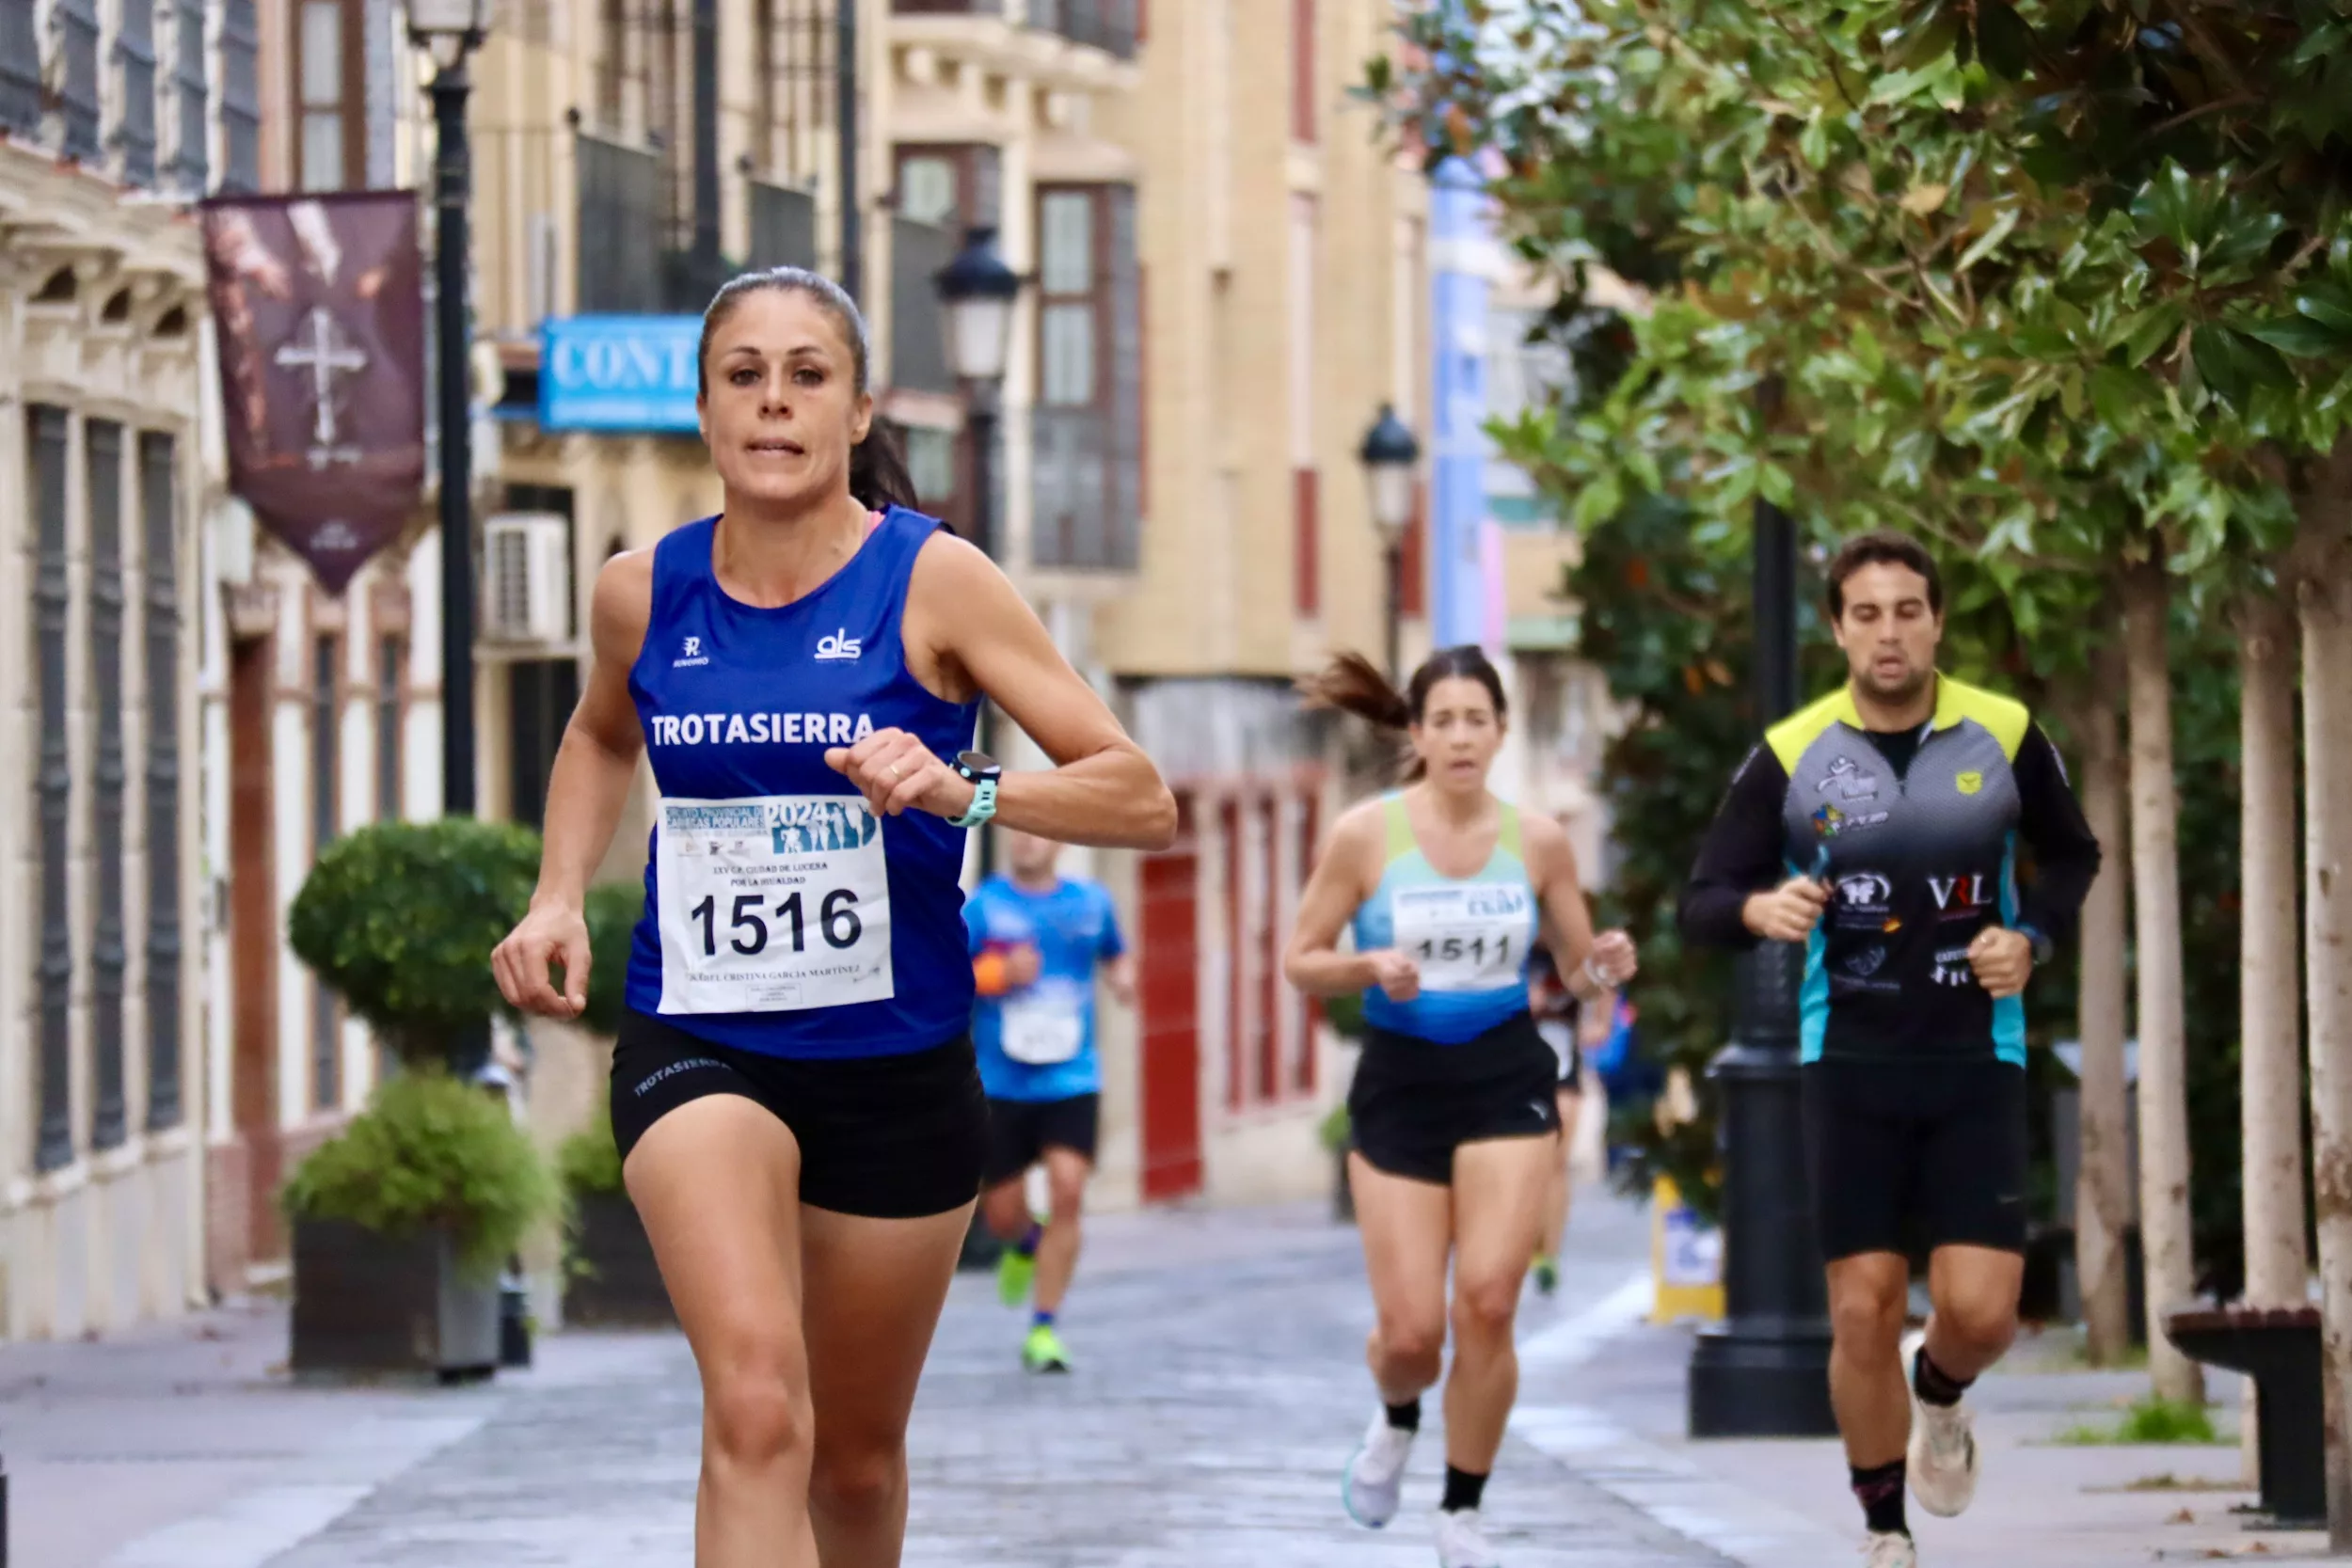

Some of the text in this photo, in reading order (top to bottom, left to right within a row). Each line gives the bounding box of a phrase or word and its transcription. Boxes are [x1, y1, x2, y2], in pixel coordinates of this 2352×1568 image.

[551, 336, 696, 388] CONT
[651, 713, 874, 746] TROTASIERRA
[713, 816, 766, 829] POPULARES
[766, 802, 830, 829] 2024
[746, 863, 777, 875] CIUDAD
[779, 863, 790, 874] DE
[1927, 875, 1993, 910] VRL
[691, 889, 862, 957] 1516
[1416, 935, 1509, 966] 1511
